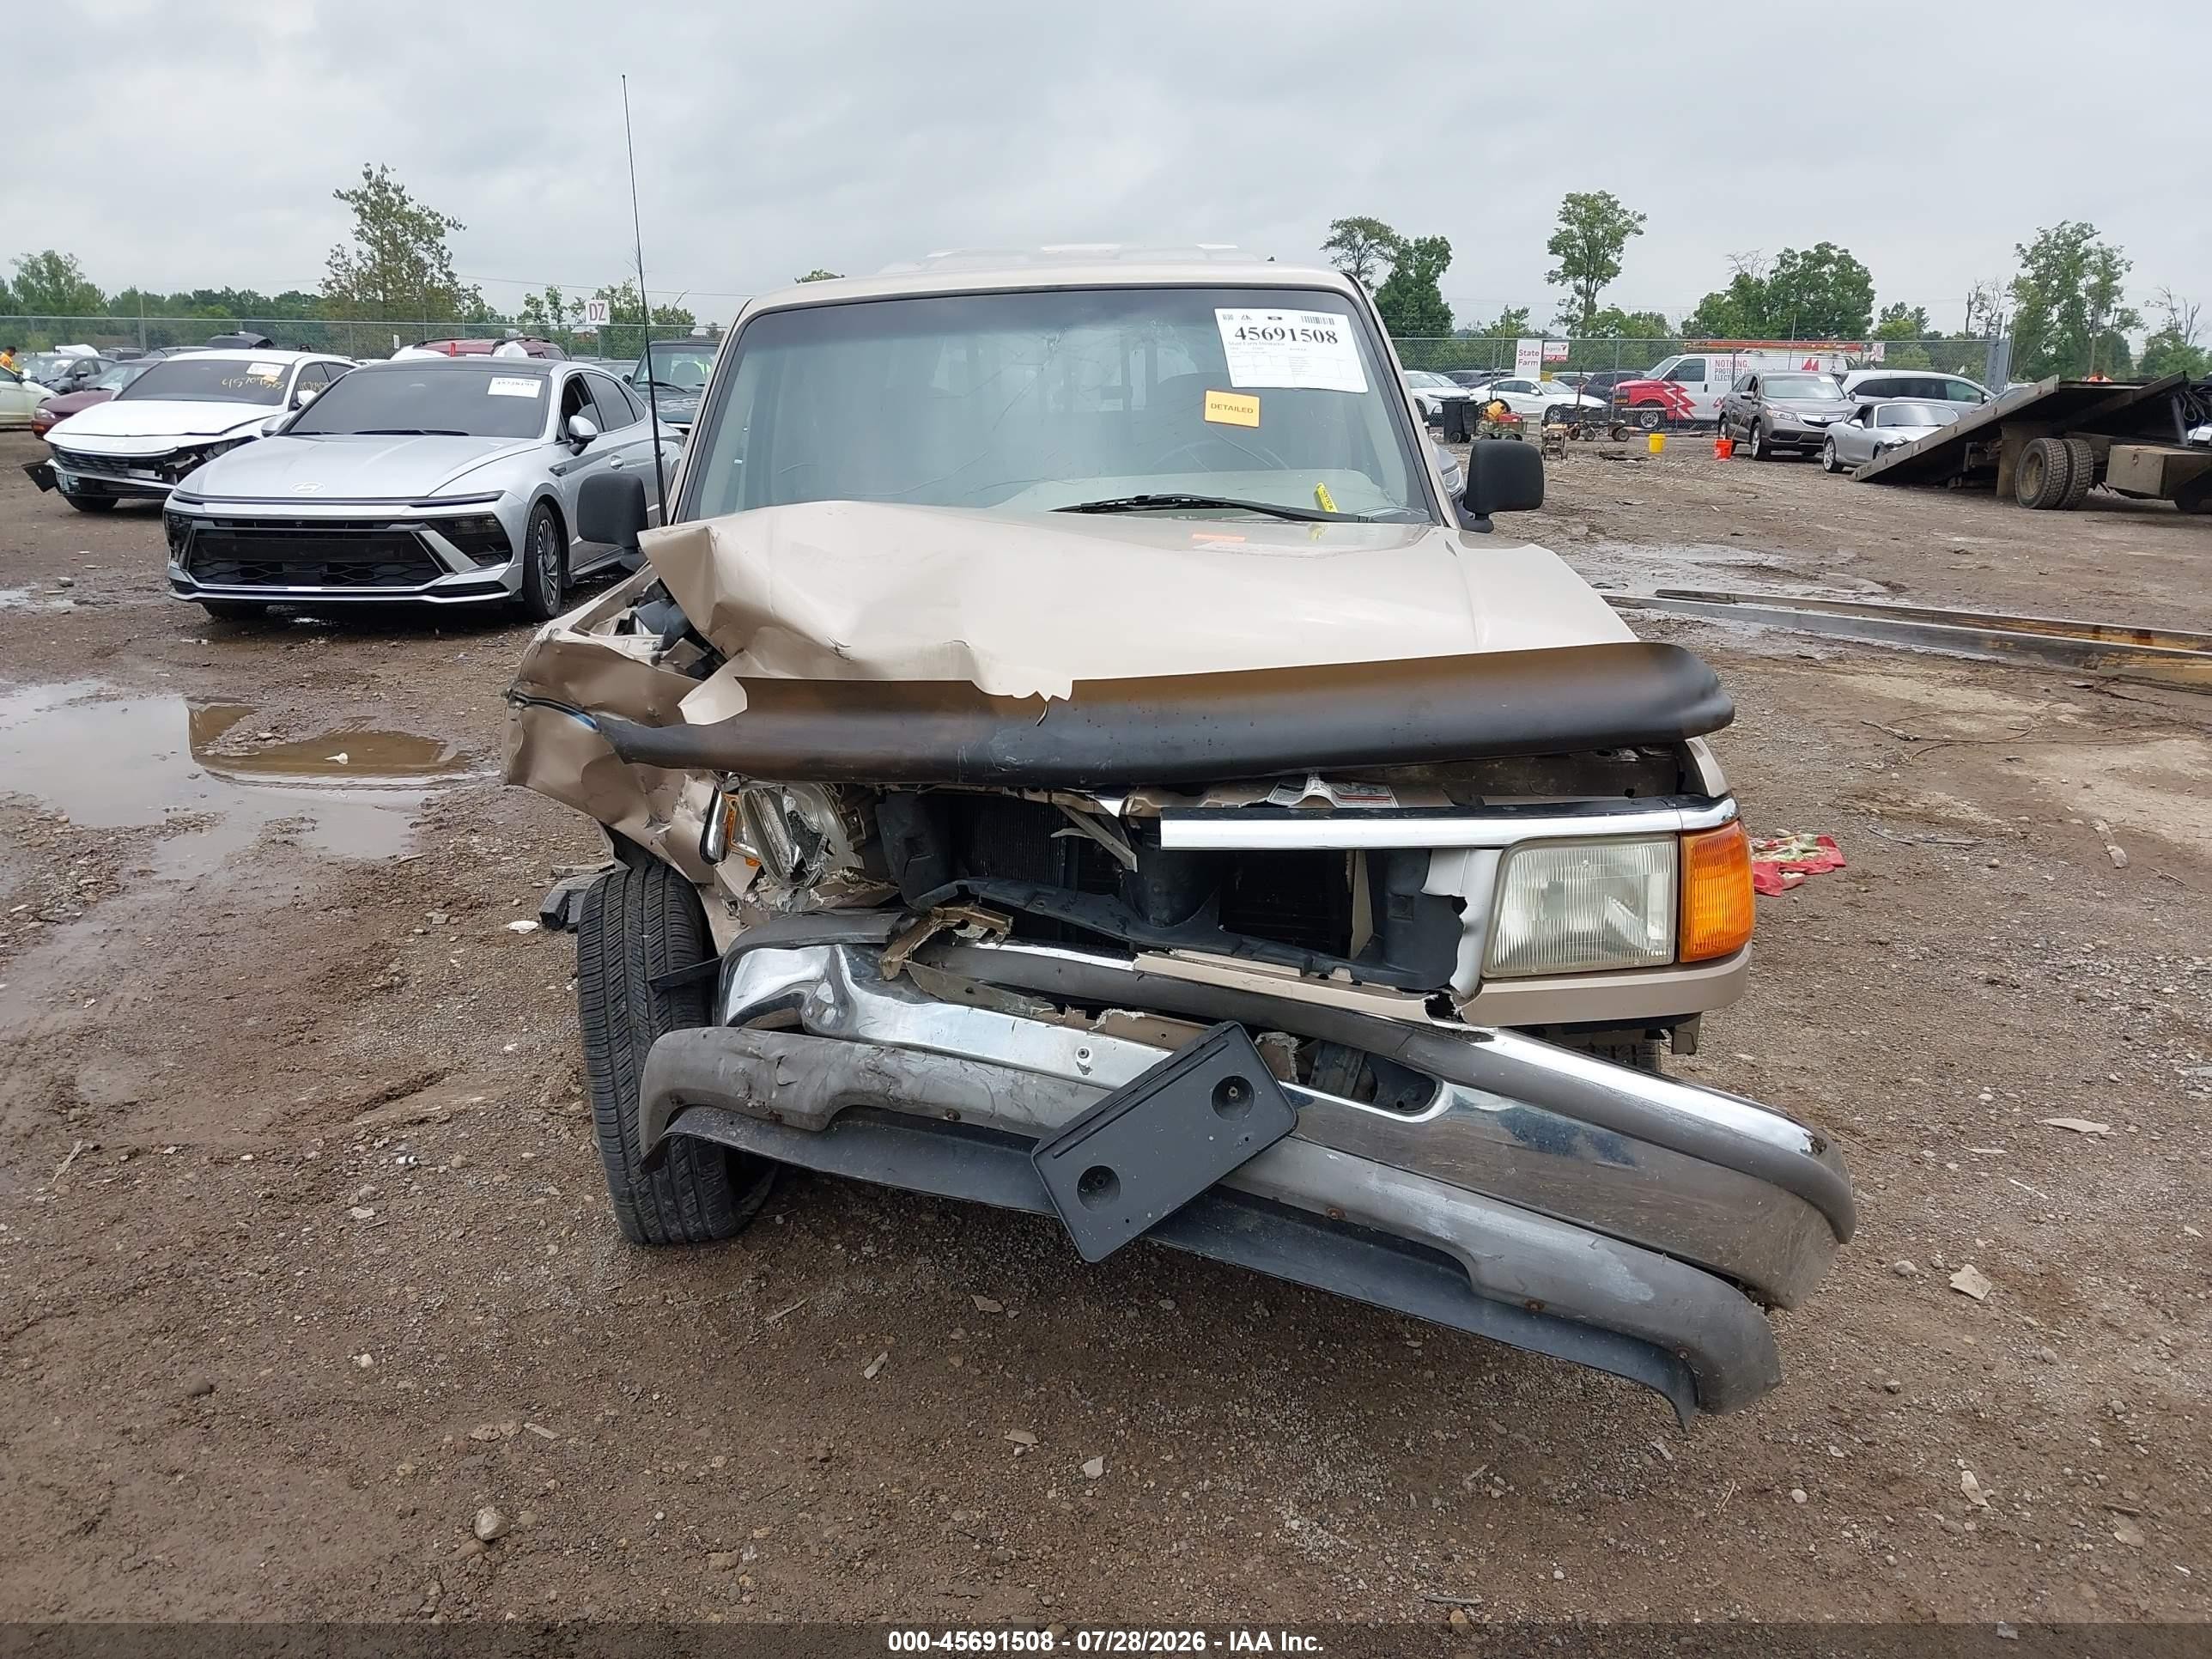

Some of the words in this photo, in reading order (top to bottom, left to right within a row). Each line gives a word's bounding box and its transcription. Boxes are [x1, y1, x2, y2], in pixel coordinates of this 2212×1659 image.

[588, 302, 606, 321] DZ
[1234, 325, 1339, 344] 45691508
[1518, 349, 1540, 357] State
[1210, 403, 1254, 414] DETAILED
